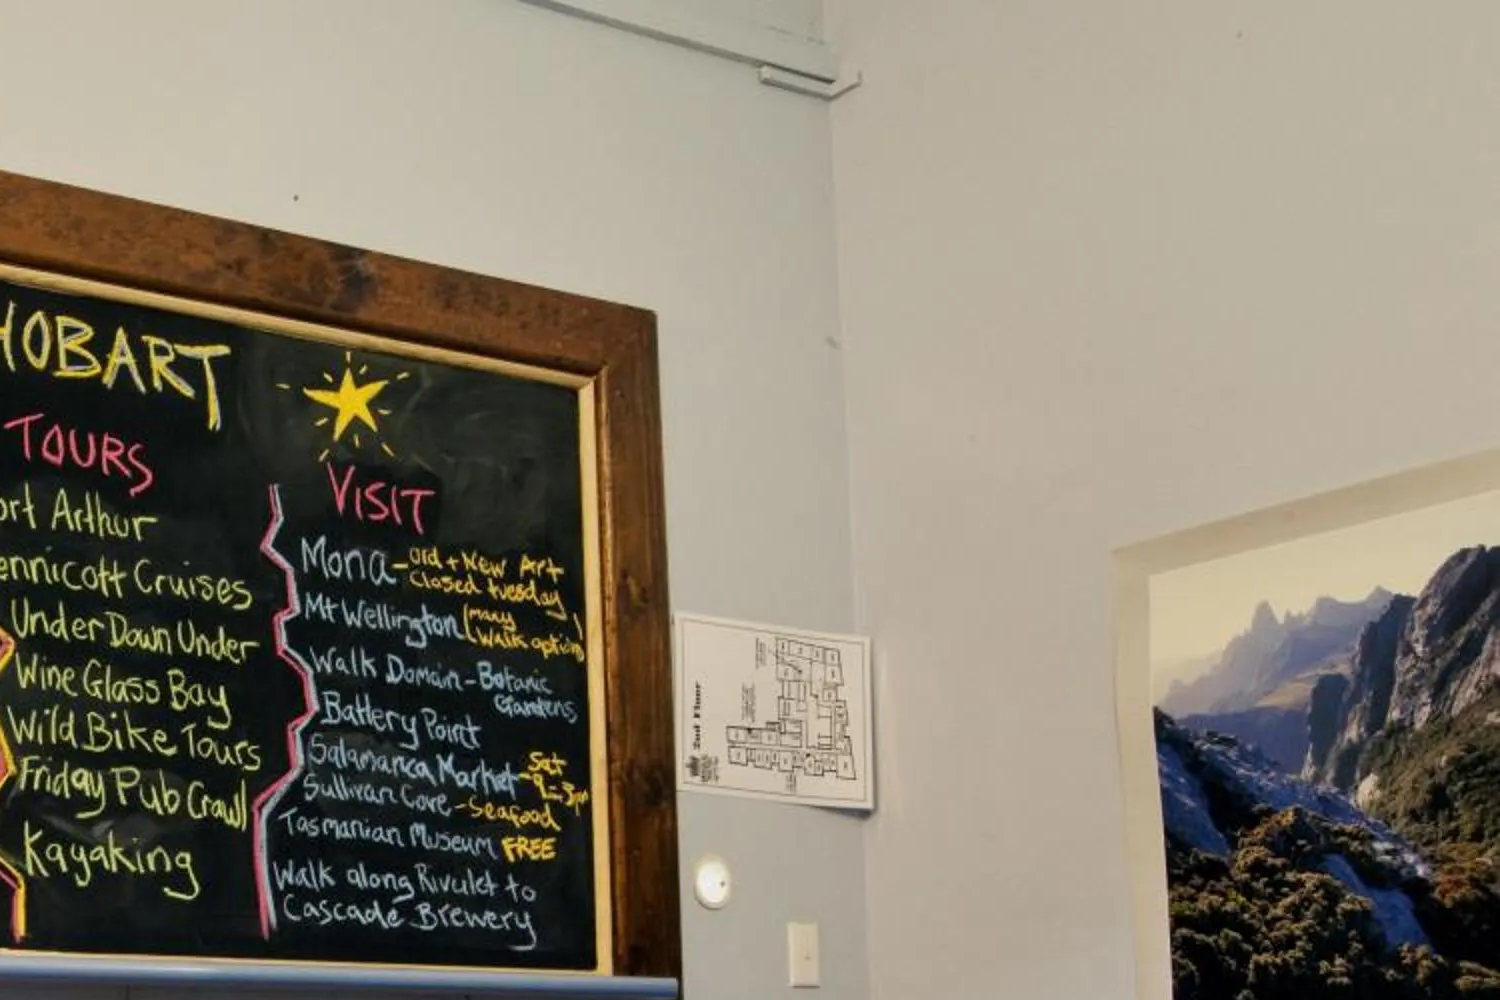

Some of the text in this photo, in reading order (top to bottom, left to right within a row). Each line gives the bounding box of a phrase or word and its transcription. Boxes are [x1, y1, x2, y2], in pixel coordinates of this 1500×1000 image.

[4, 412, 154, 498] TOURS
[50, 487, 159, 541] Arthur
[327, 463, 435, 535] VISIT
[133, 558, 252, 610] Cruises
[520, 553, 564, 584] Art
[11, 597, 260, 665] Under Down Under
[304, 591, 338, 623] Mt
[340, 598, 466, 649] Wellington
[15, 651, 232, 729] Wine Glass Bay
[309, 646, 378, 679] Walk
[7, 705, 261, 771] Wild Bike Tours
[320, 690, 482, 751] Battery Point
[303, 773, 398, 802] Sullivan
[309, 733, 437, 787] Salamanca
[18, 754, 249, 832] Friday Pub Crawl
[22, 820, 200, 901] Kayaking
[279, 807, 556, 864] Tasmanian Museum FREE
[272, 858, 537, 904] Walk along Rivulet to
[283, 895, 537, 950] Cascade Brewery
